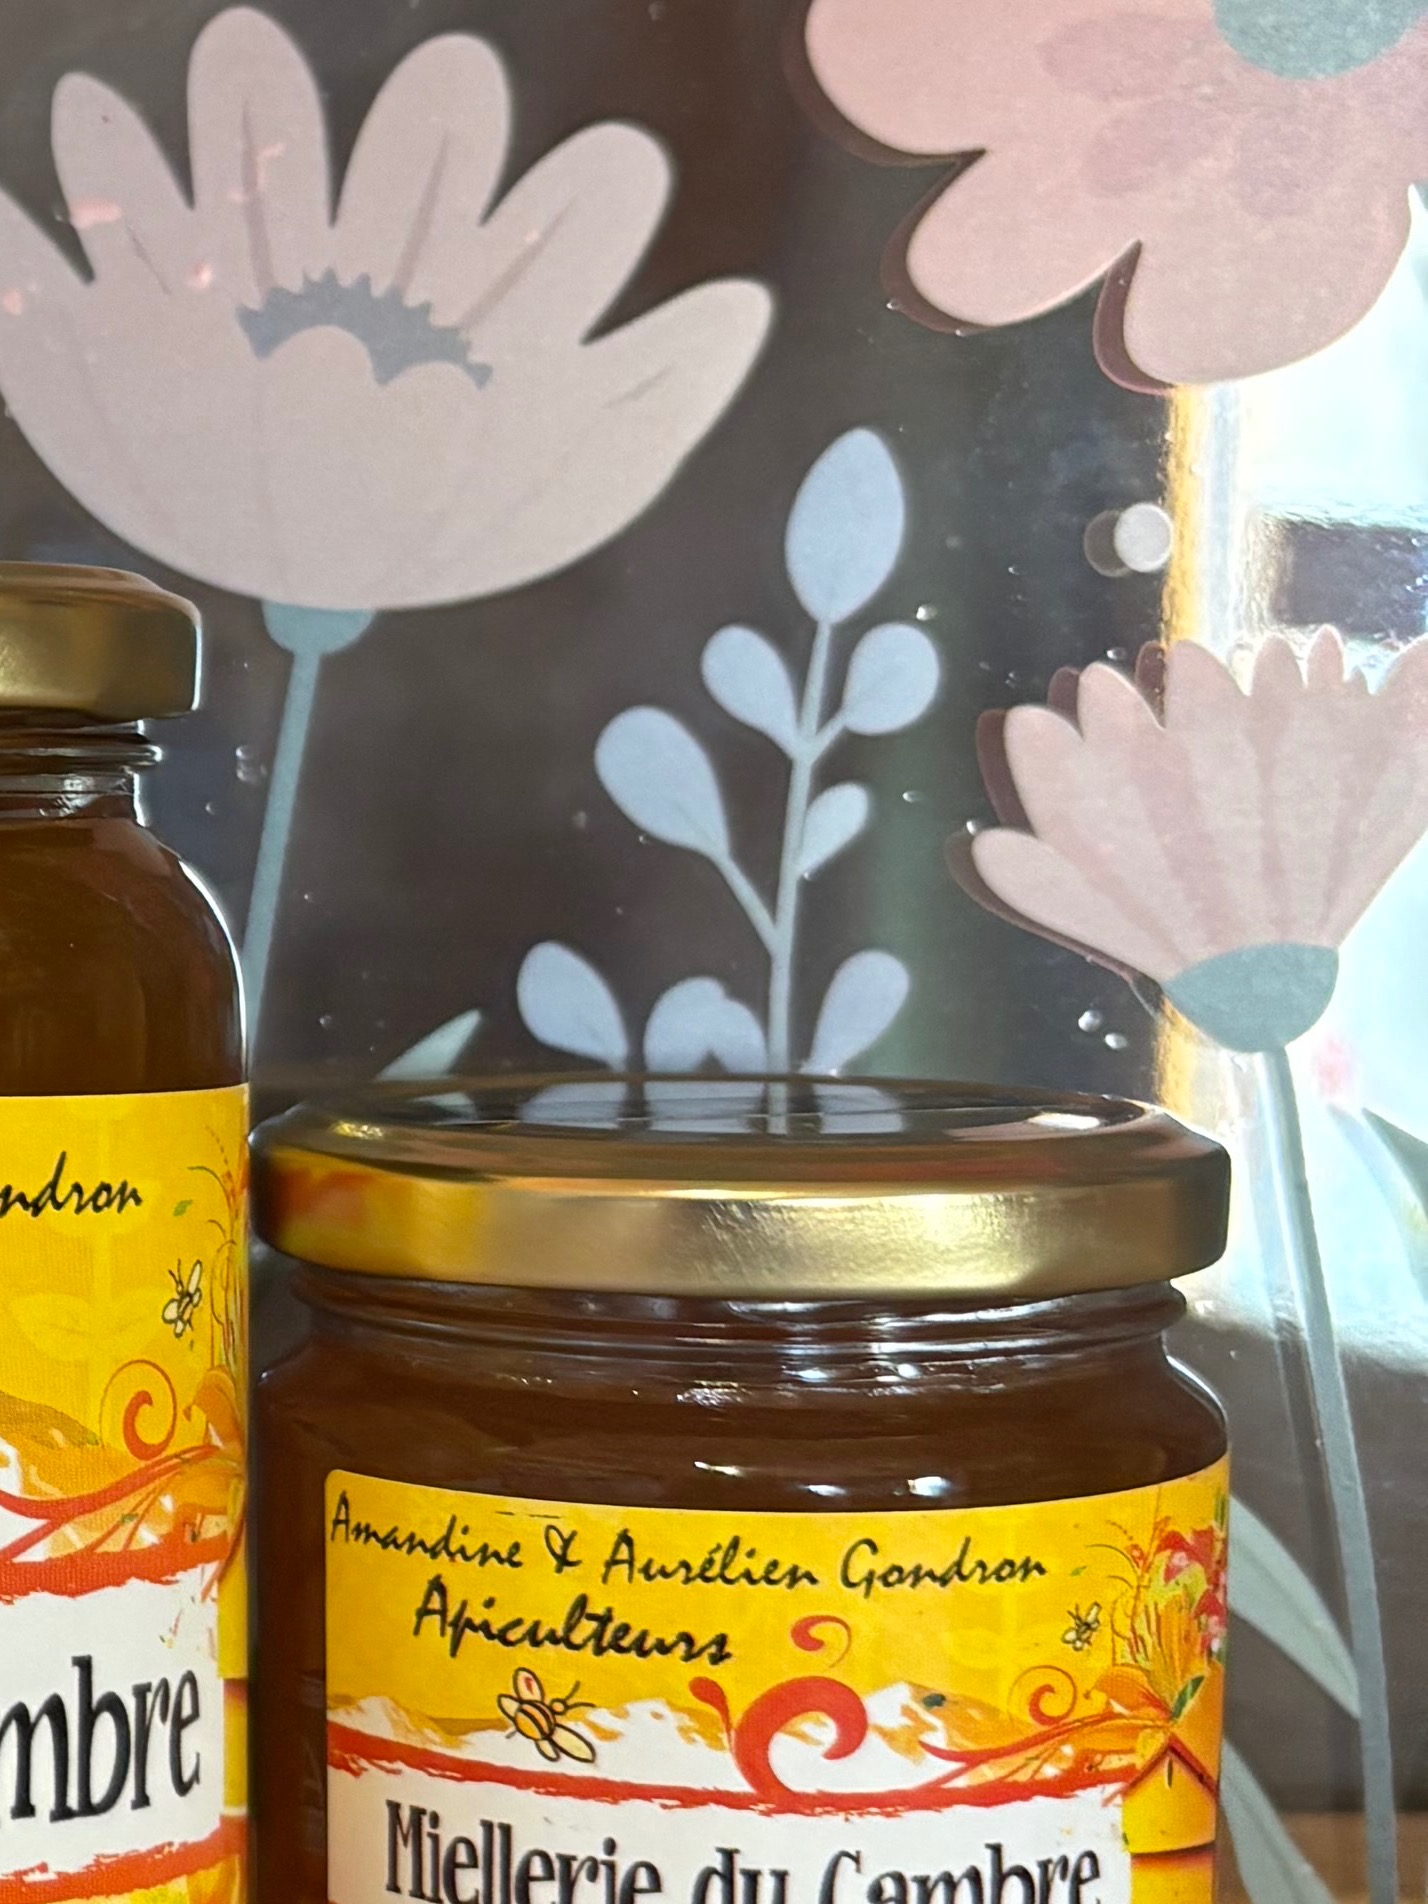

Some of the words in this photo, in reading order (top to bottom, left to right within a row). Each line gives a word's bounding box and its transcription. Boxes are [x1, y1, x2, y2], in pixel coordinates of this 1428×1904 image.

[330, 1490, 524, 1568] Amandine
[544, 1523, 582, 1574] &
[601, 1527, 819, 1589] Aurélien
[842, 1536, 1048, 1599] Gondron
[413, 1573, 733, 1666] Apiculteurs
